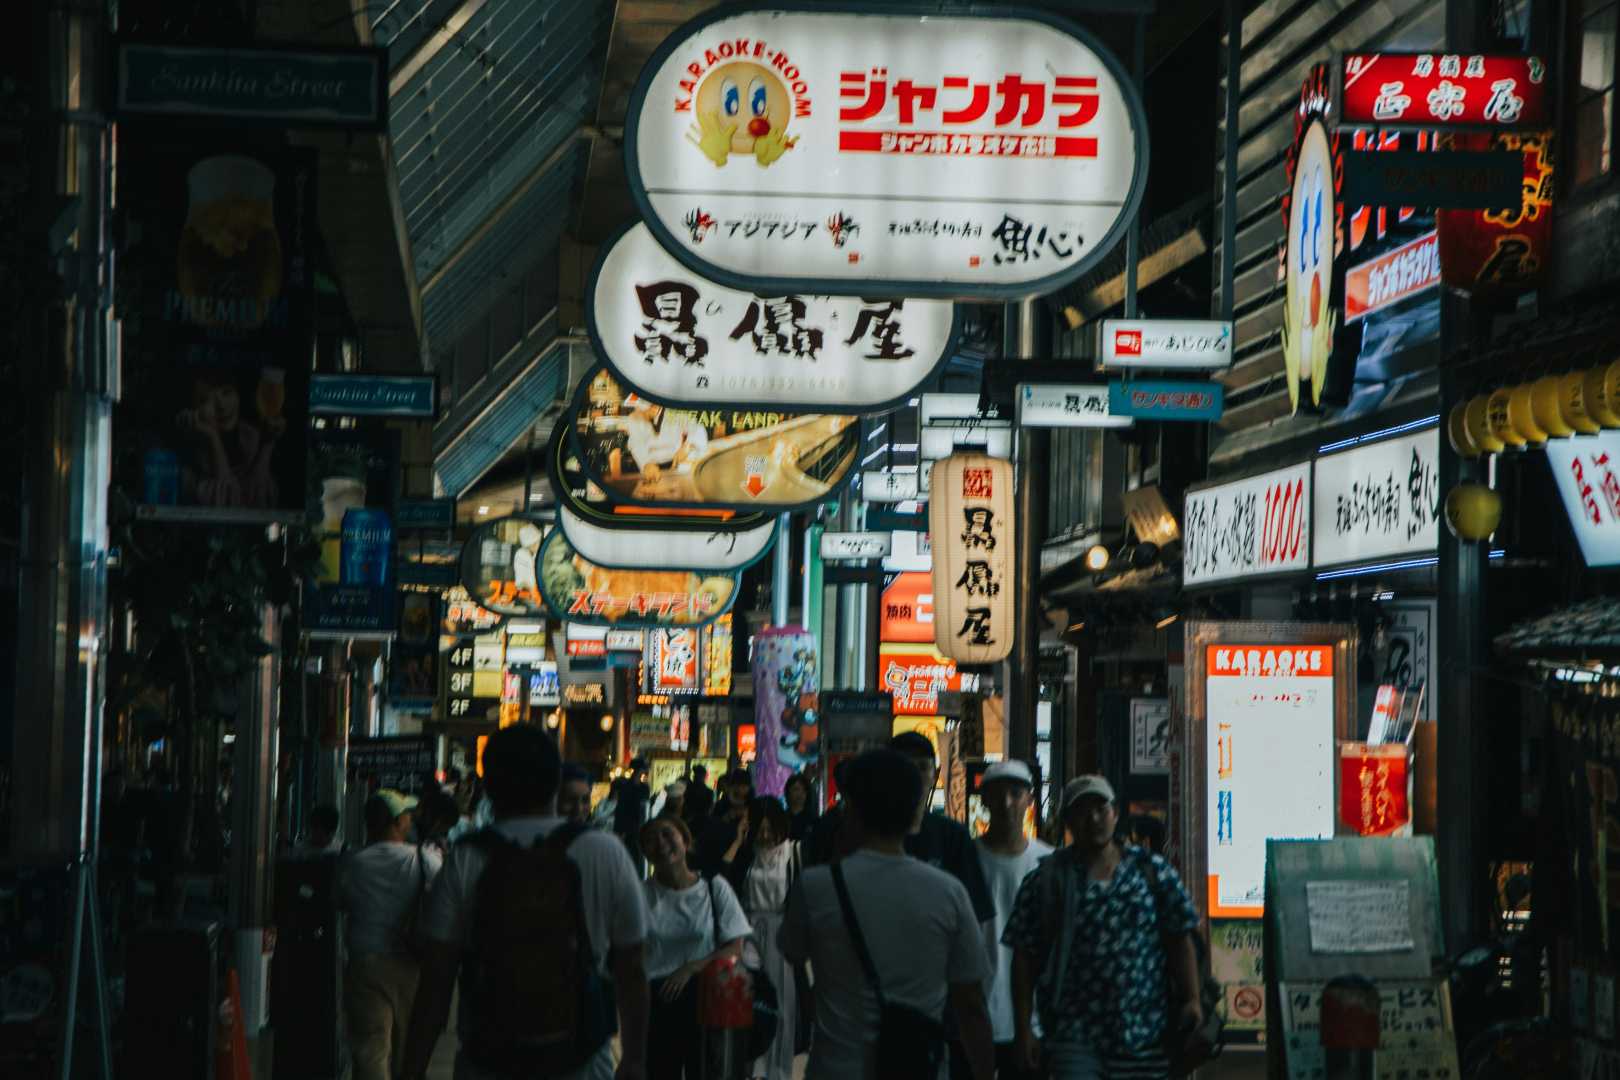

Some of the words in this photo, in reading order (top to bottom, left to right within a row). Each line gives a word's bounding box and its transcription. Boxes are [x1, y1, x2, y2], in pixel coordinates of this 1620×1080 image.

[263, 67, 348, 98] Street
[839, 69, 1099, 129] ジャンカラ
[732, 410, 779, 430] LAND
[568, 590, 714, 617] ステーキランド
[451, 648, 473, 666] 4F
[1216, 650, 1322, 671] KARAOKE
[451, 673, 473, 693] 3F
[451, 699, 470, 717] 2F
